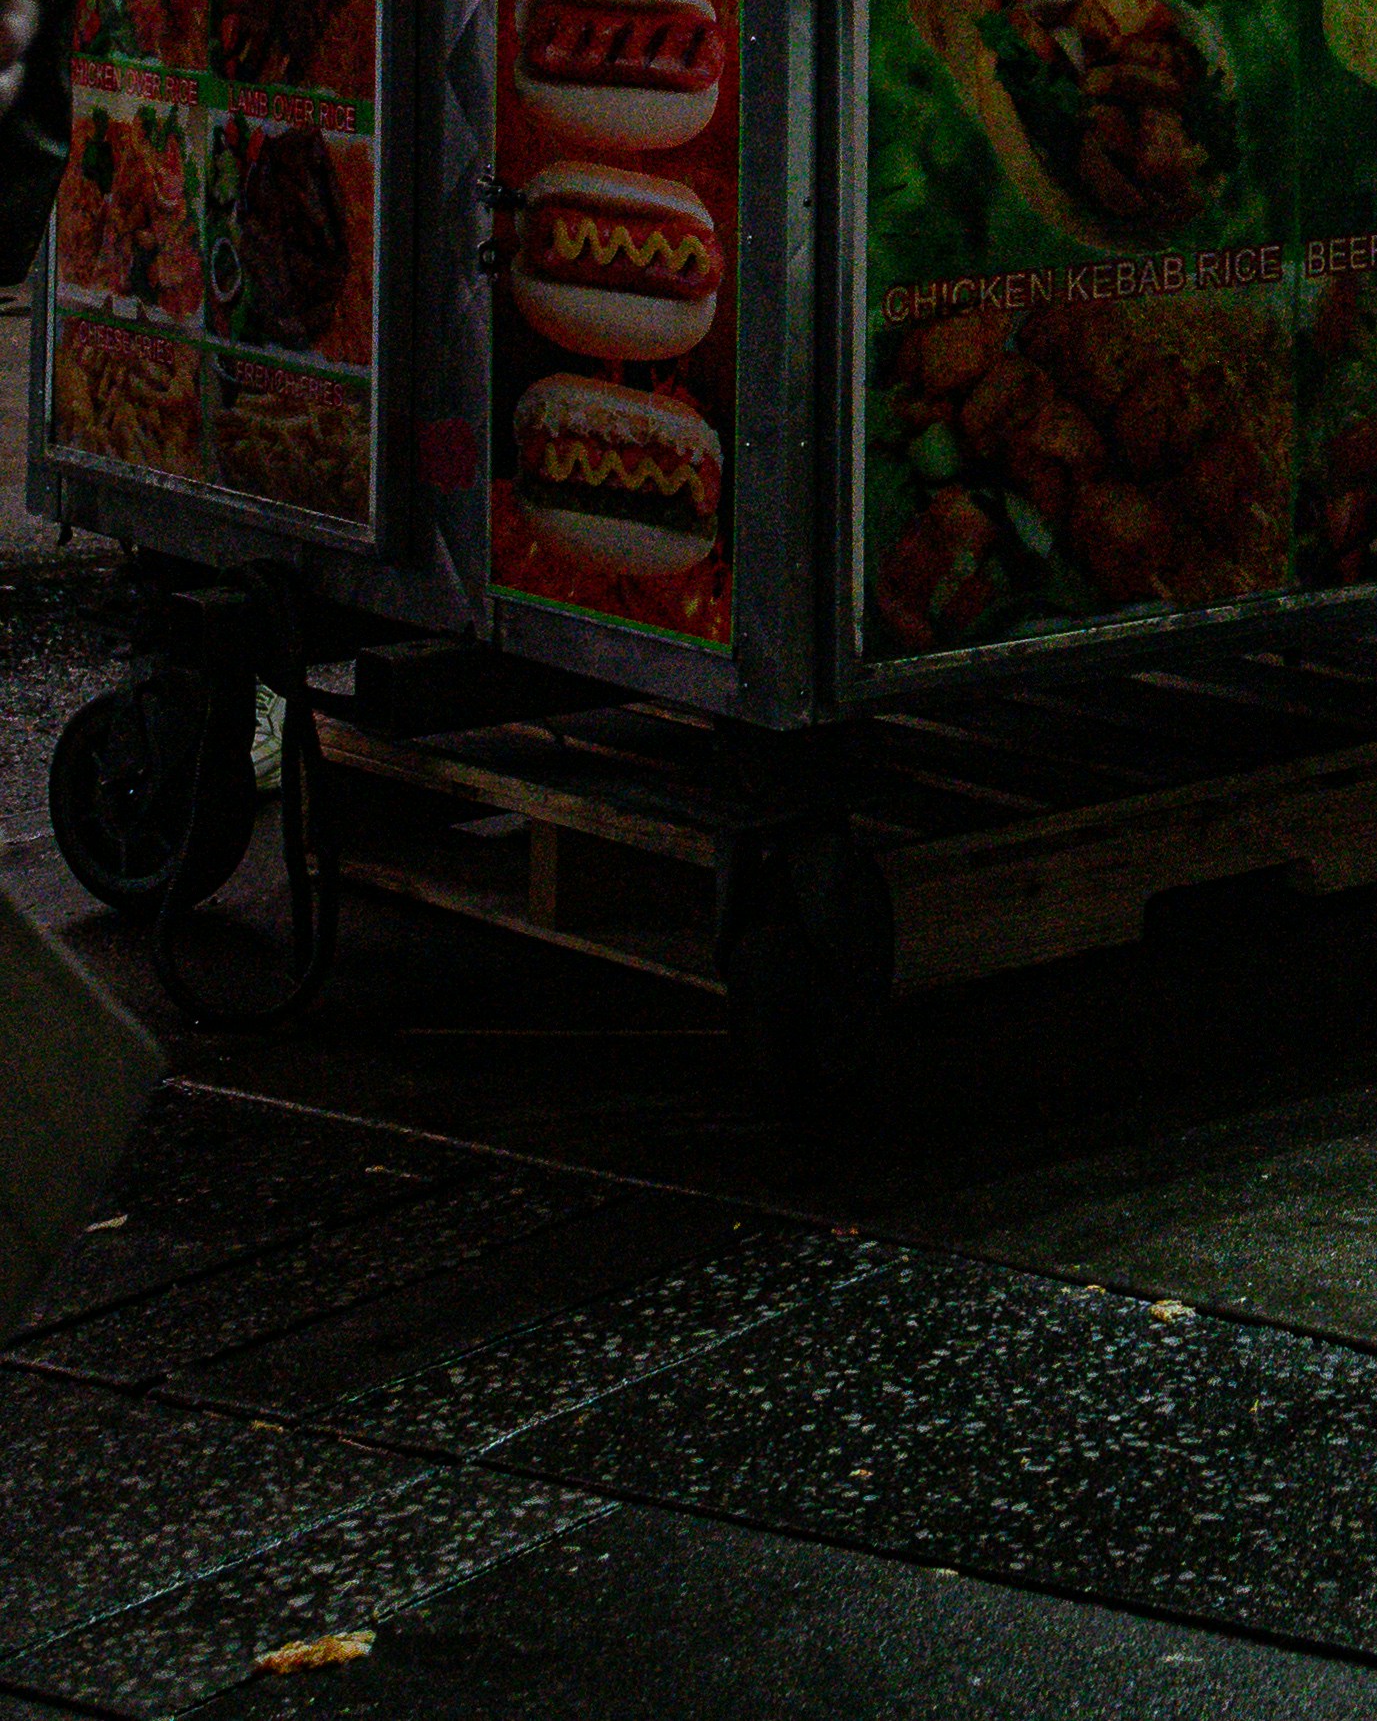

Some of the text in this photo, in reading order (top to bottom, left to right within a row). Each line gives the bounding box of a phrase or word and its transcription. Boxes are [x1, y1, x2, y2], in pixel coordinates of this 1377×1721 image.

[882, 244, 1282, 324] CHICKEN KEBAB RICE
